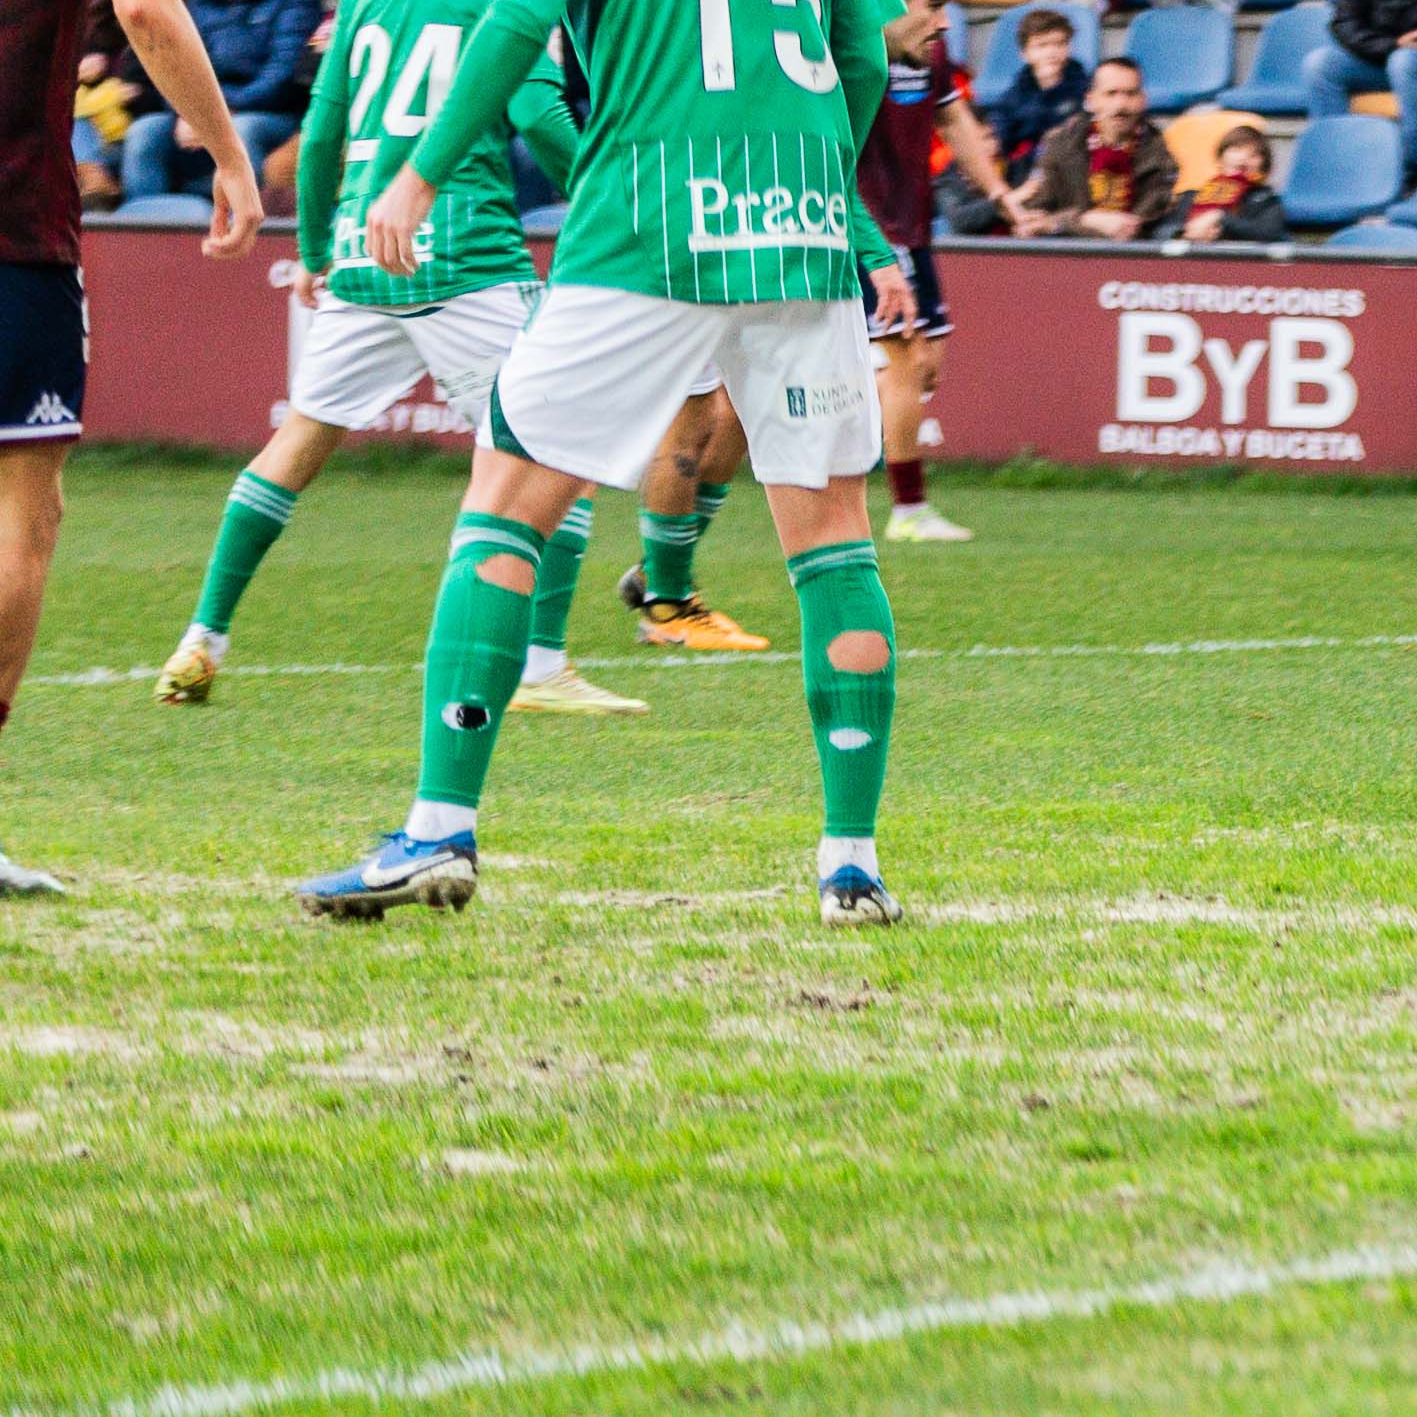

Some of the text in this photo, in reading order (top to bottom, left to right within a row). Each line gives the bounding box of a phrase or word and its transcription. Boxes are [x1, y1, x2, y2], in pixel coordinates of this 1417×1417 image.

[347, 22, 464, 162] 24
[684, 177, 848, 237] Prace
[1098, 280, 1367, 318] CONSTRUCCIONES
[1220, 429, 1247, 458] Y
[1244, 430, 1367, 462] BUCETA
